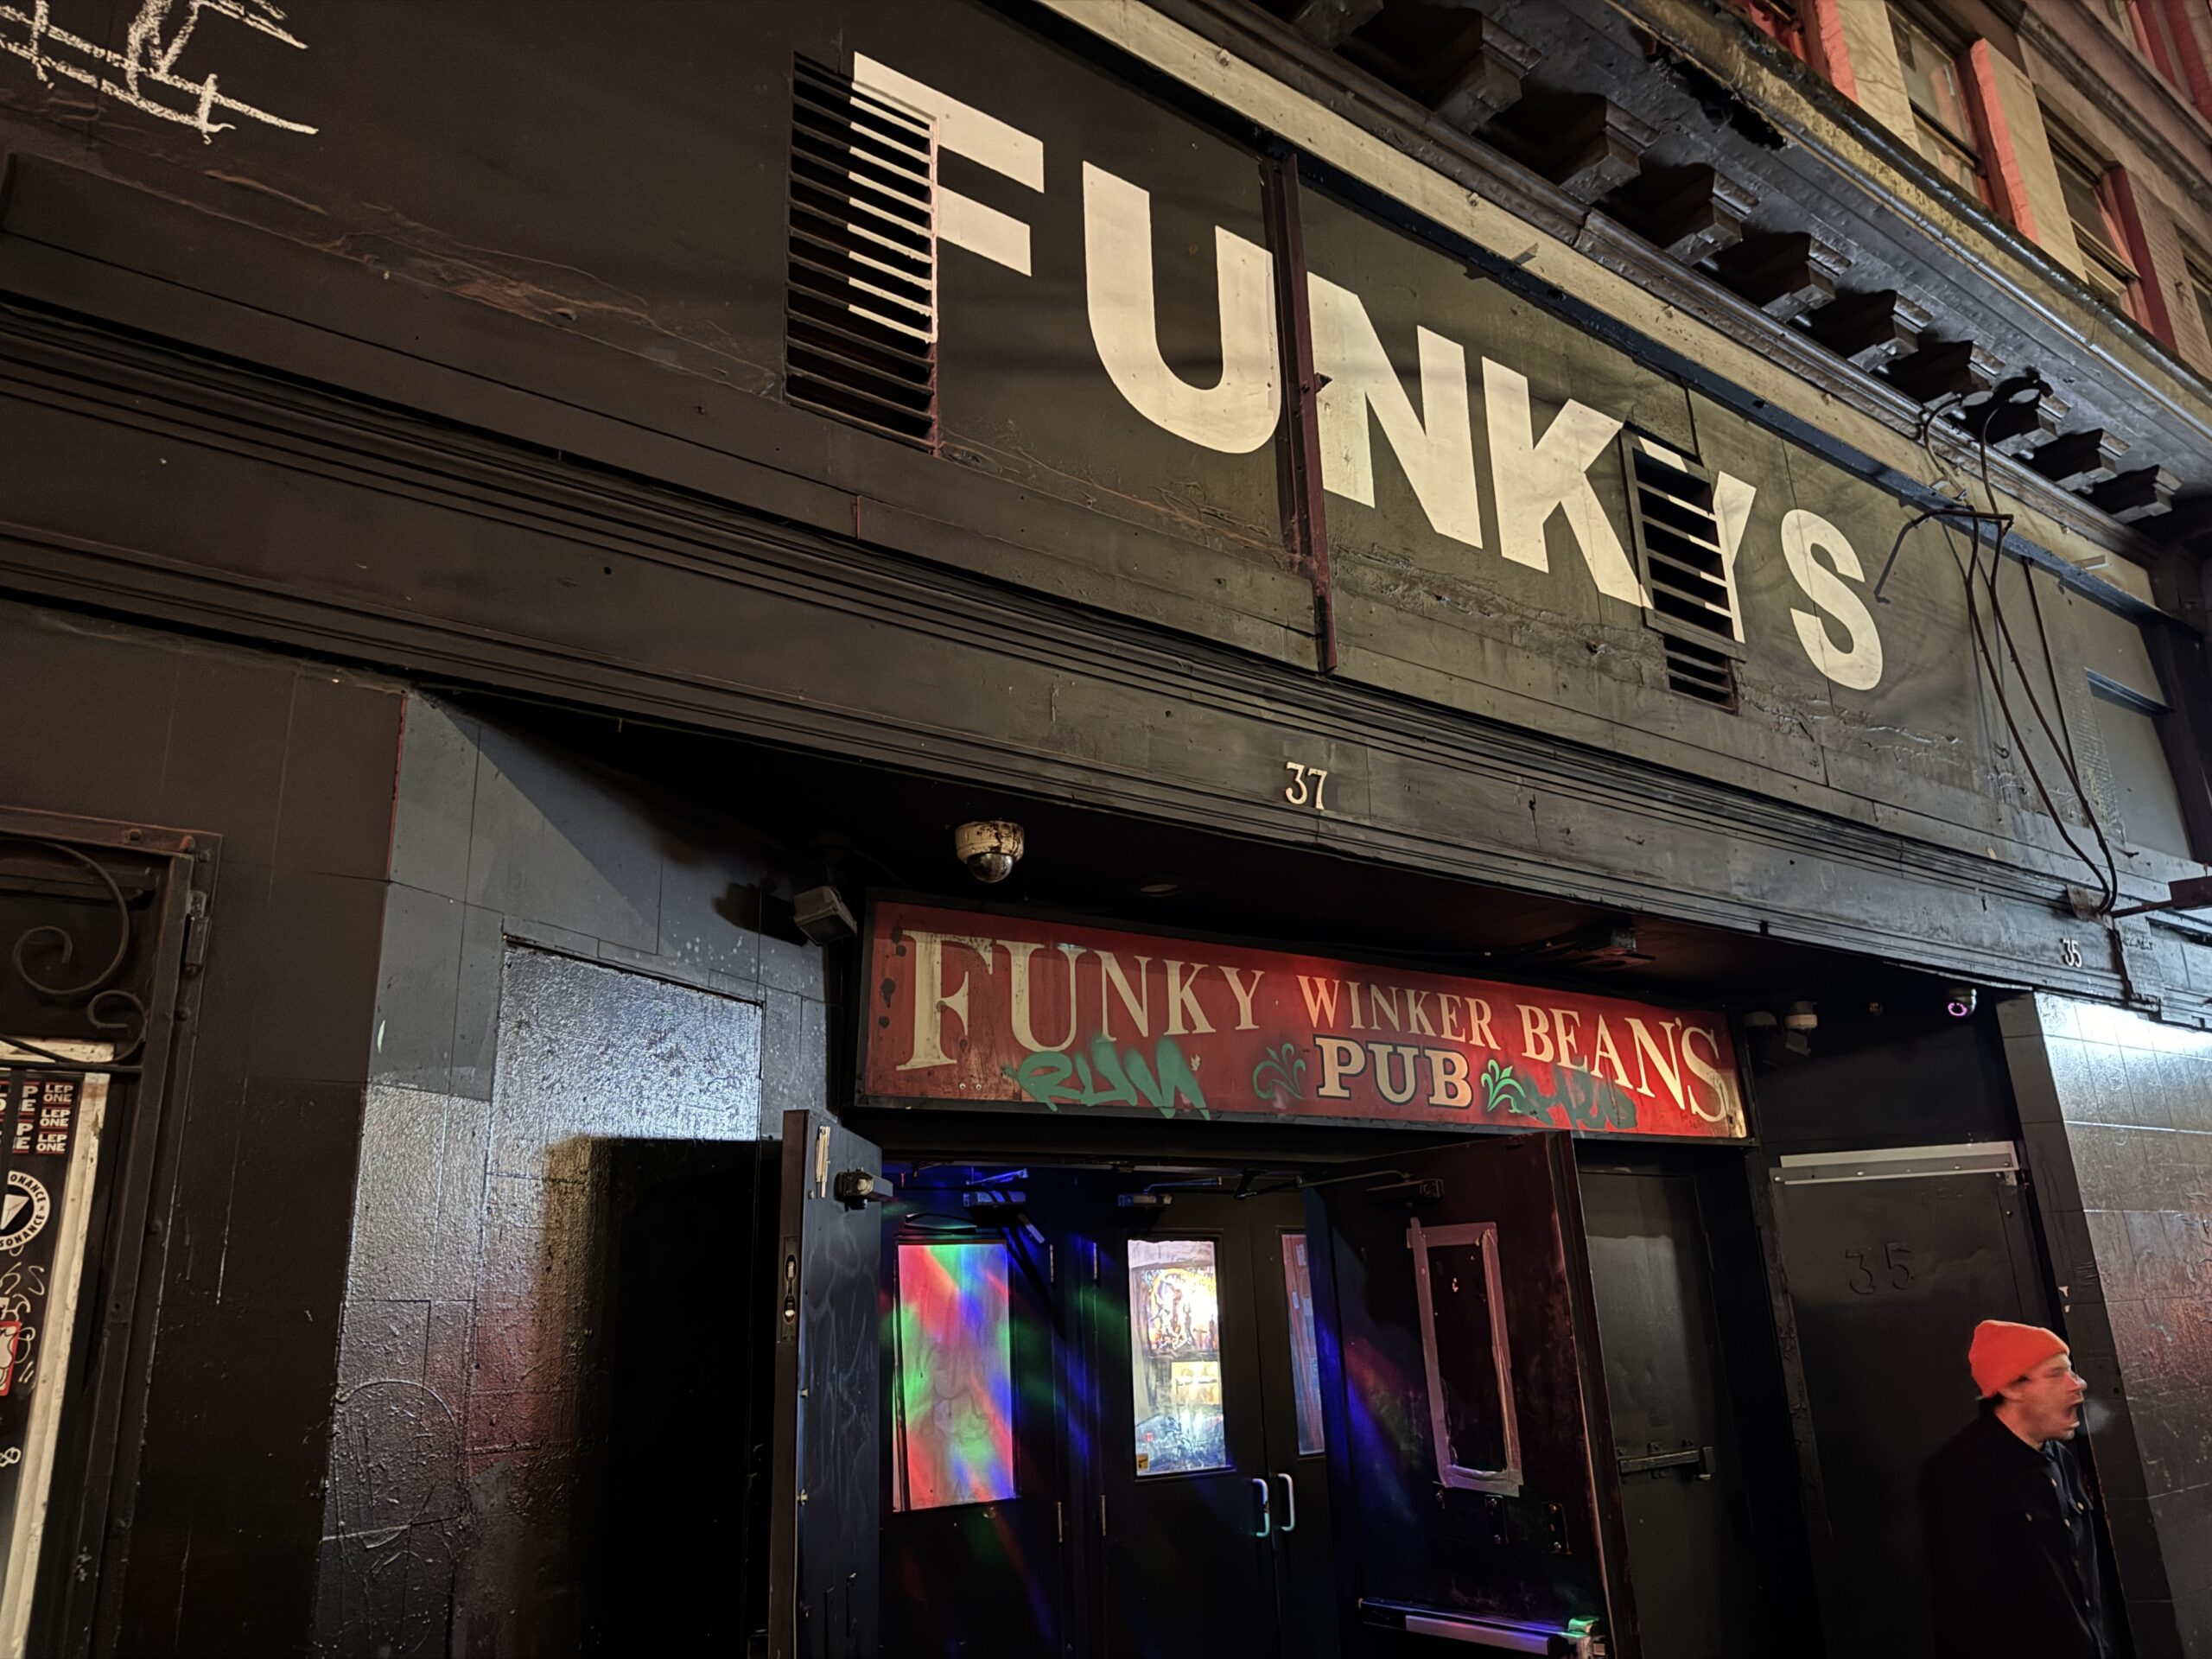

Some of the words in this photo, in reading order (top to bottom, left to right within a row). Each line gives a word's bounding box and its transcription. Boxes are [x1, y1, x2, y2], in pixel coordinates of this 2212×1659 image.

[849, 50, 1884, 691] FUNKYS
[1285, 761, 1328, 810] 37
[2060, 938, 2082, 968] 35
[896, 929, 1265, 1071] FUNKY
[1296, 974, 1501, 1052] WINKER
[1515, 1002, 1730, 1124] BEAN'S
[1313, 1034, 1474, 1109] PUB
[42, 1093, 73, 1103] ONE
[45, 1084, 74, 1094] LEP
[39, 1118, 69, 1128] ONE
[41, 1109, 71, 1118] LEP
[35, 1142, 66, 1152] ONE
[37, 1134, 68, 1143] LEP
[10, 1173, 47, 1203] ONANCE
[1845, 1243, 1912, 1295] 35
